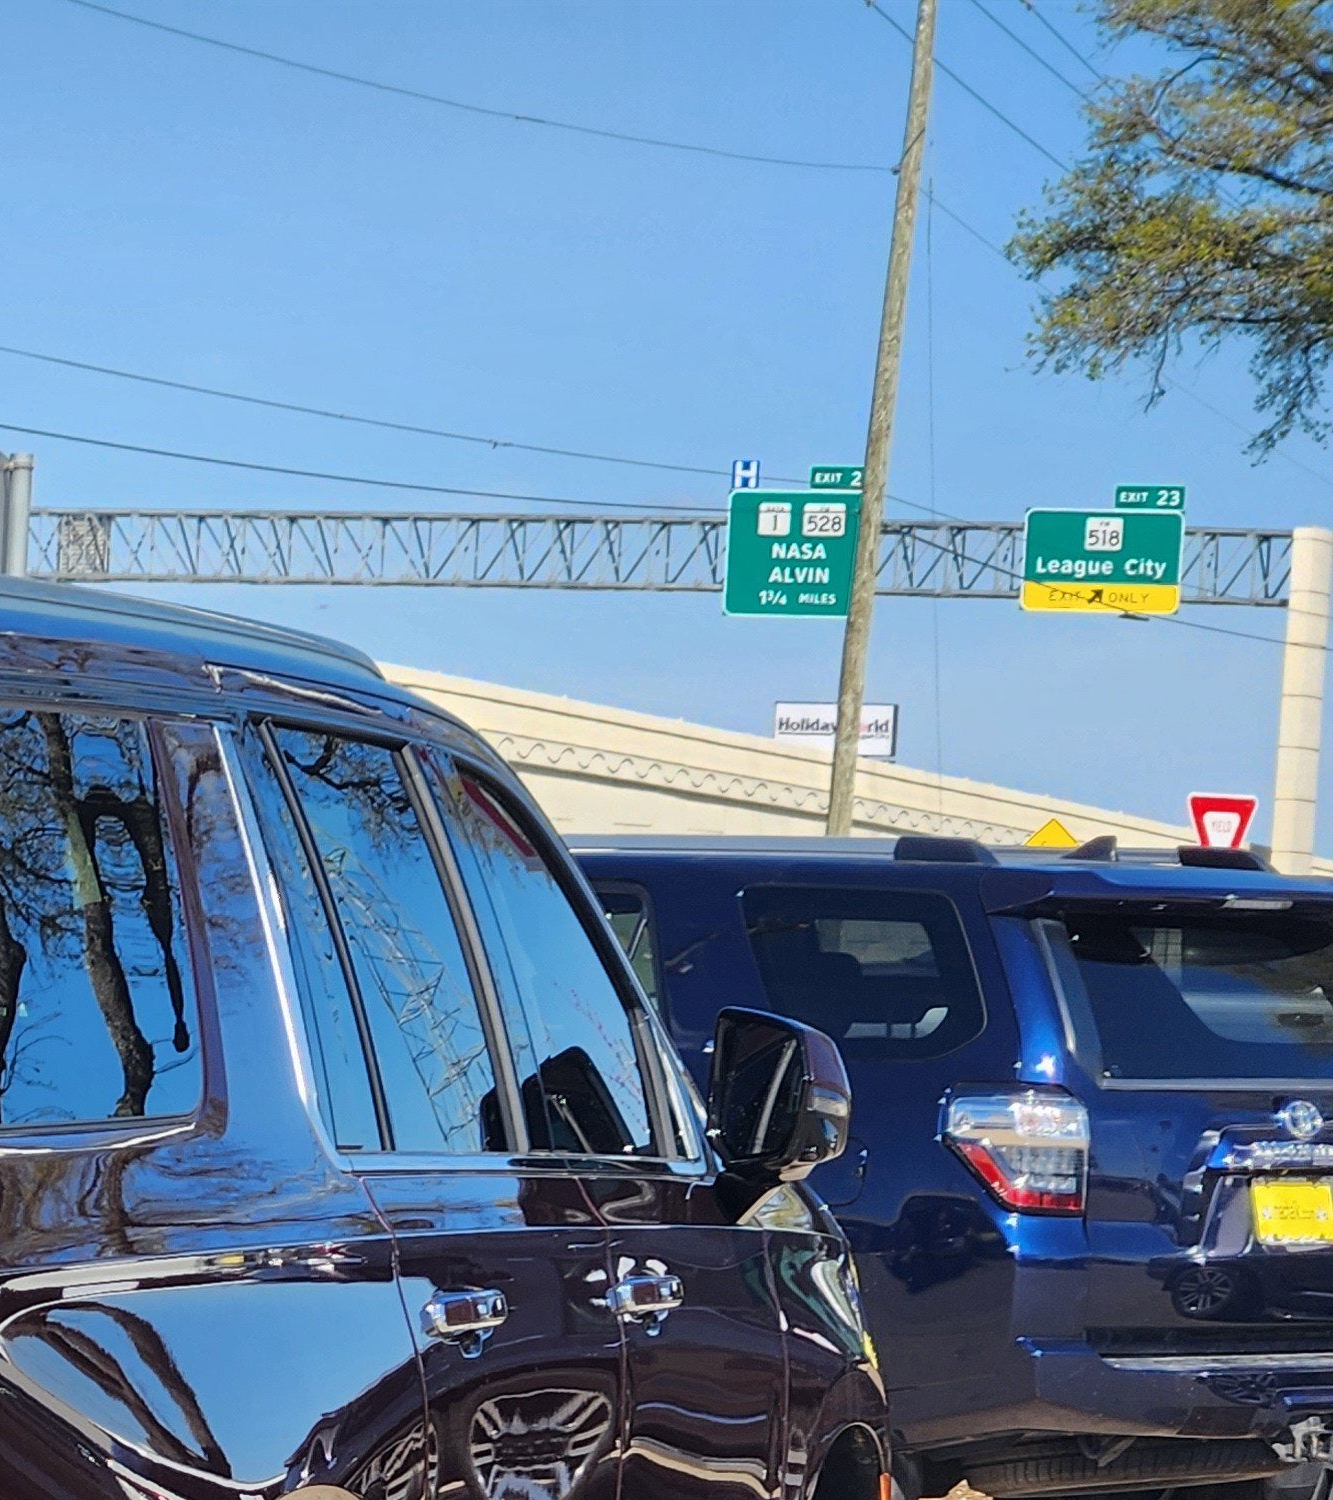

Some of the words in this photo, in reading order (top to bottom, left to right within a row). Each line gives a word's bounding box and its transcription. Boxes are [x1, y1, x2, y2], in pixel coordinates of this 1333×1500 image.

[734, 460, 758, 489] H
[814, 472, 843, 484] EXIT
[1119, 491, 1149, 503] EXIT
[1156, 490, 1181, 507] 23
[772, 515, 779, 532] 1
[807, 515, 842, 533] 528
[1088, 529, 1120, 547] 518
[771, 542, 827, 560] NASA
[768, 566, 830, 584] ALVIN
[1035, 556, 1114, 579] League
[1123, 557, 1167, 580] City
[798, 592, 837, 606] MILES
[1108, 592, 1150, 604] ONLY
